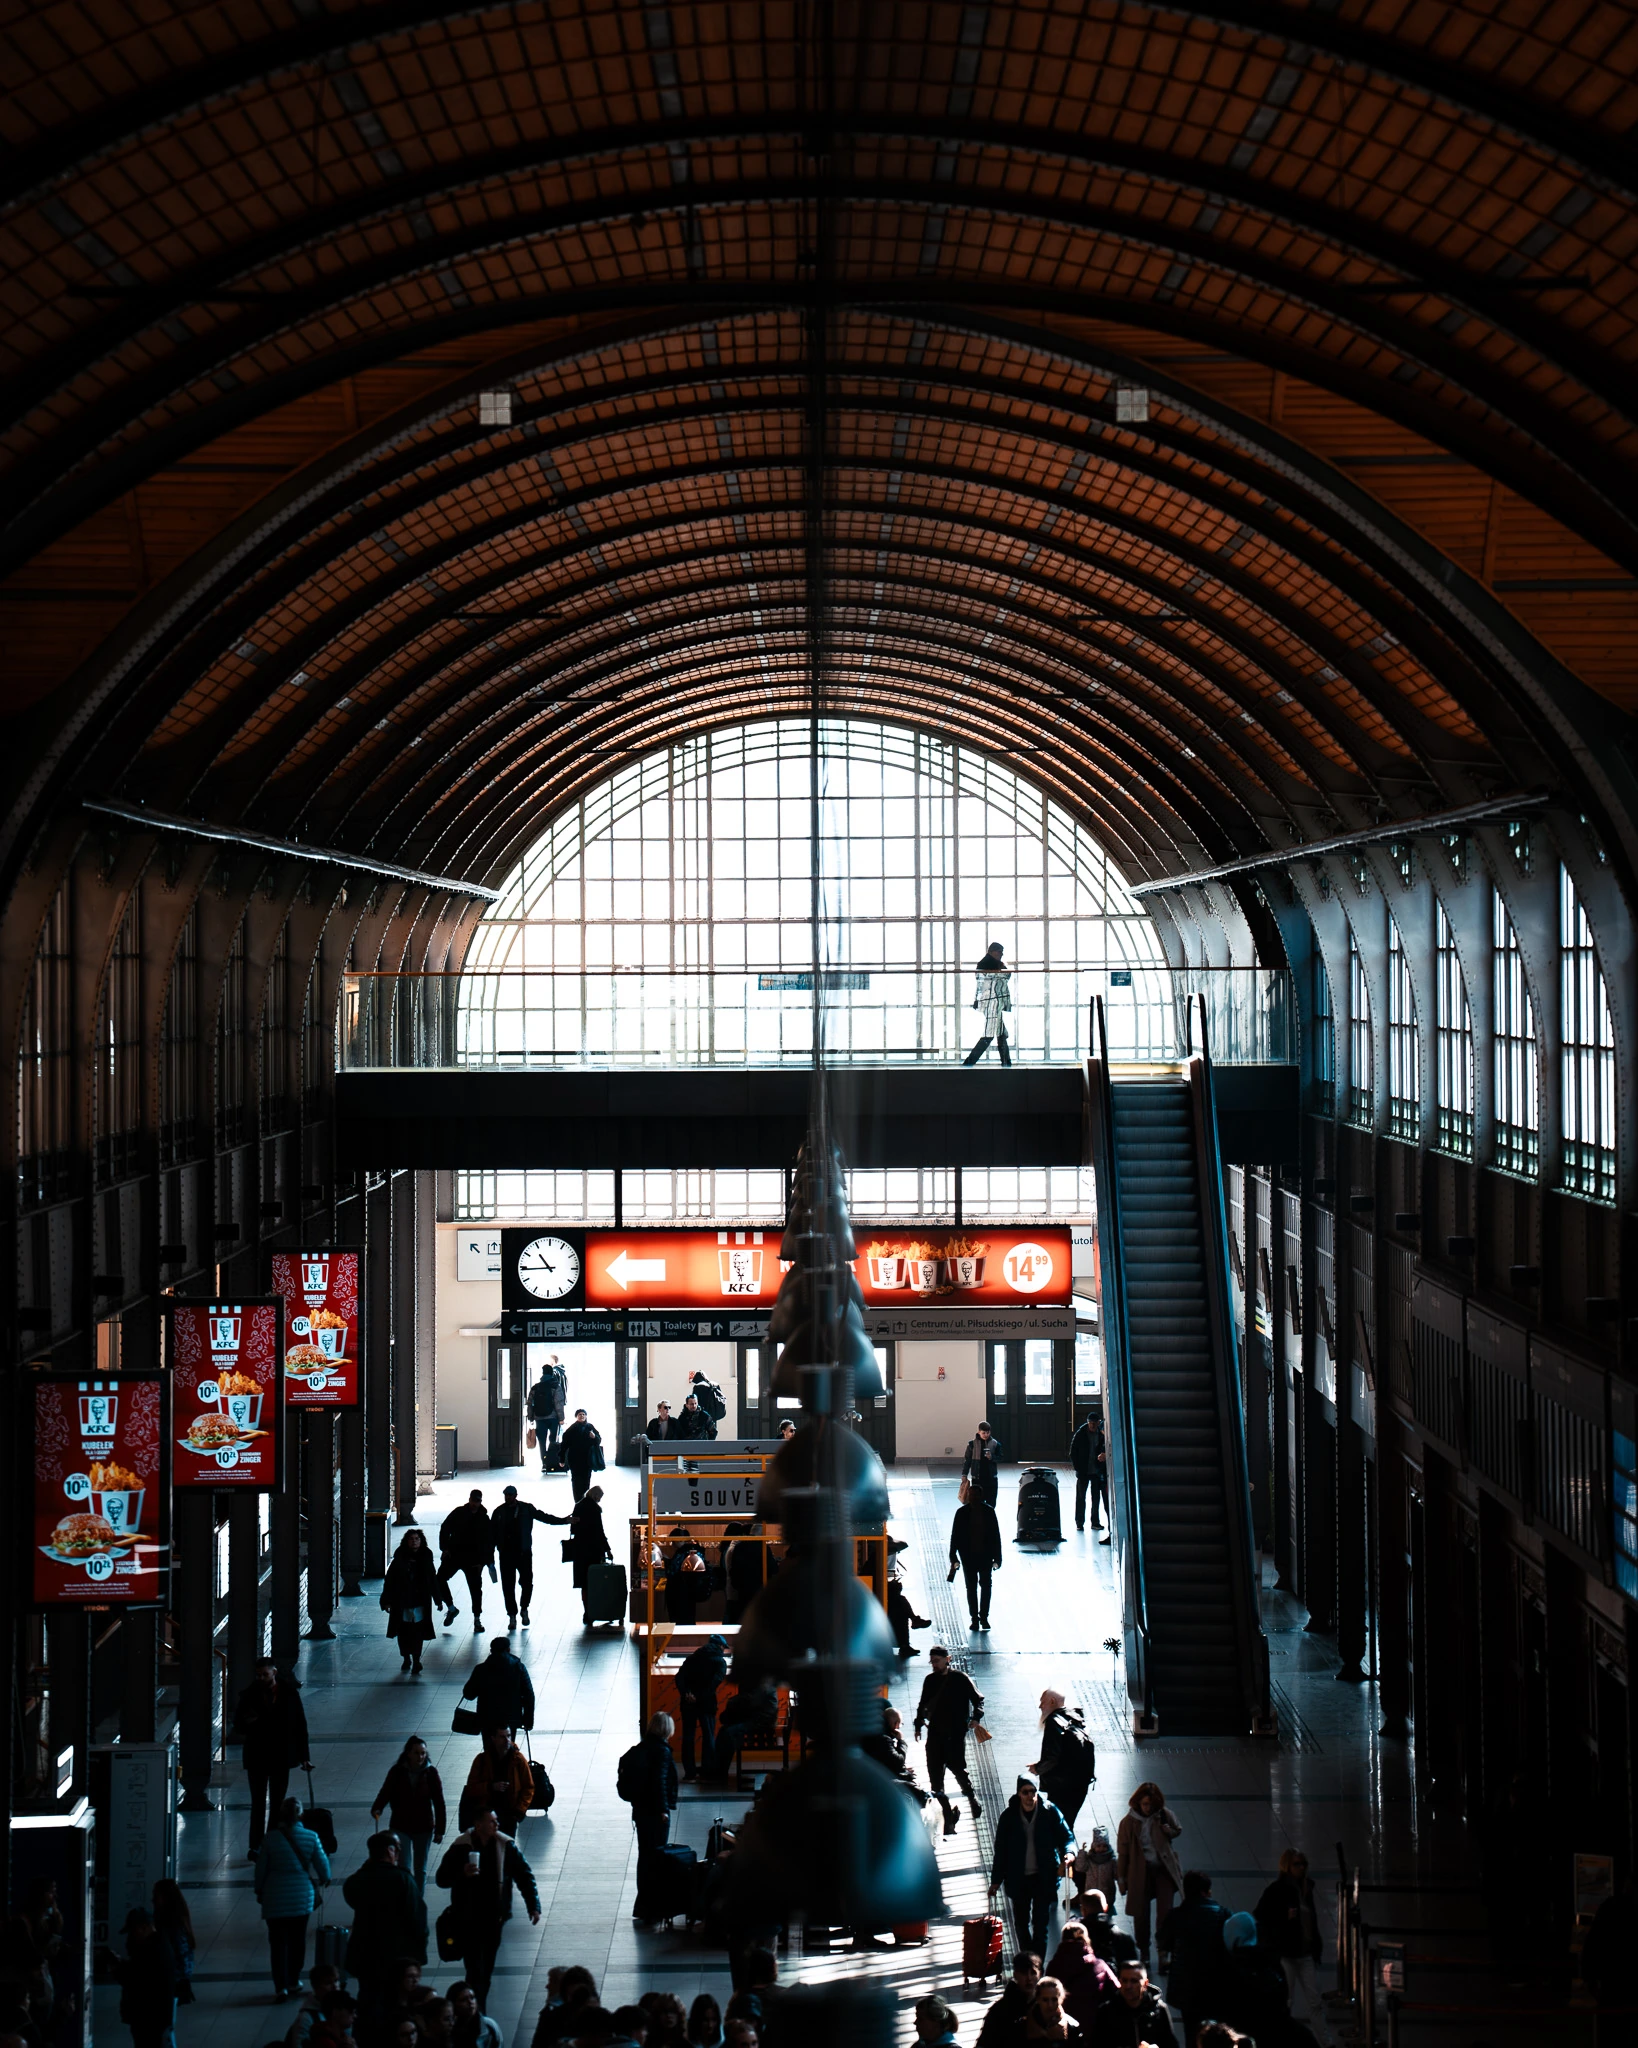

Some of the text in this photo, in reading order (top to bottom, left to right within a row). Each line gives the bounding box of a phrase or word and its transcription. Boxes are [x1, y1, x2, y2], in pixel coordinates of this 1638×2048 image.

[728, 1283, 754, 1292] KFC
[577, 1322, 622, 1332] Parking C
[664, 1321, 696, 1332] Toalety
[910, 1320, 948, 1328] Centrum
[955, 1320, 966, 1328] ul.
[968, 1319, 1023, 1330] Piłsudskiego
[1029, 1320, 1040, 1328] ul.
[1042, 1319, 1068, 1328] Sucha
[87, 1425, 110, 1433] KFC
[240, 1456, 261, 1464] ZINGER
[690, 1490, 754, 1506] SOUVE
